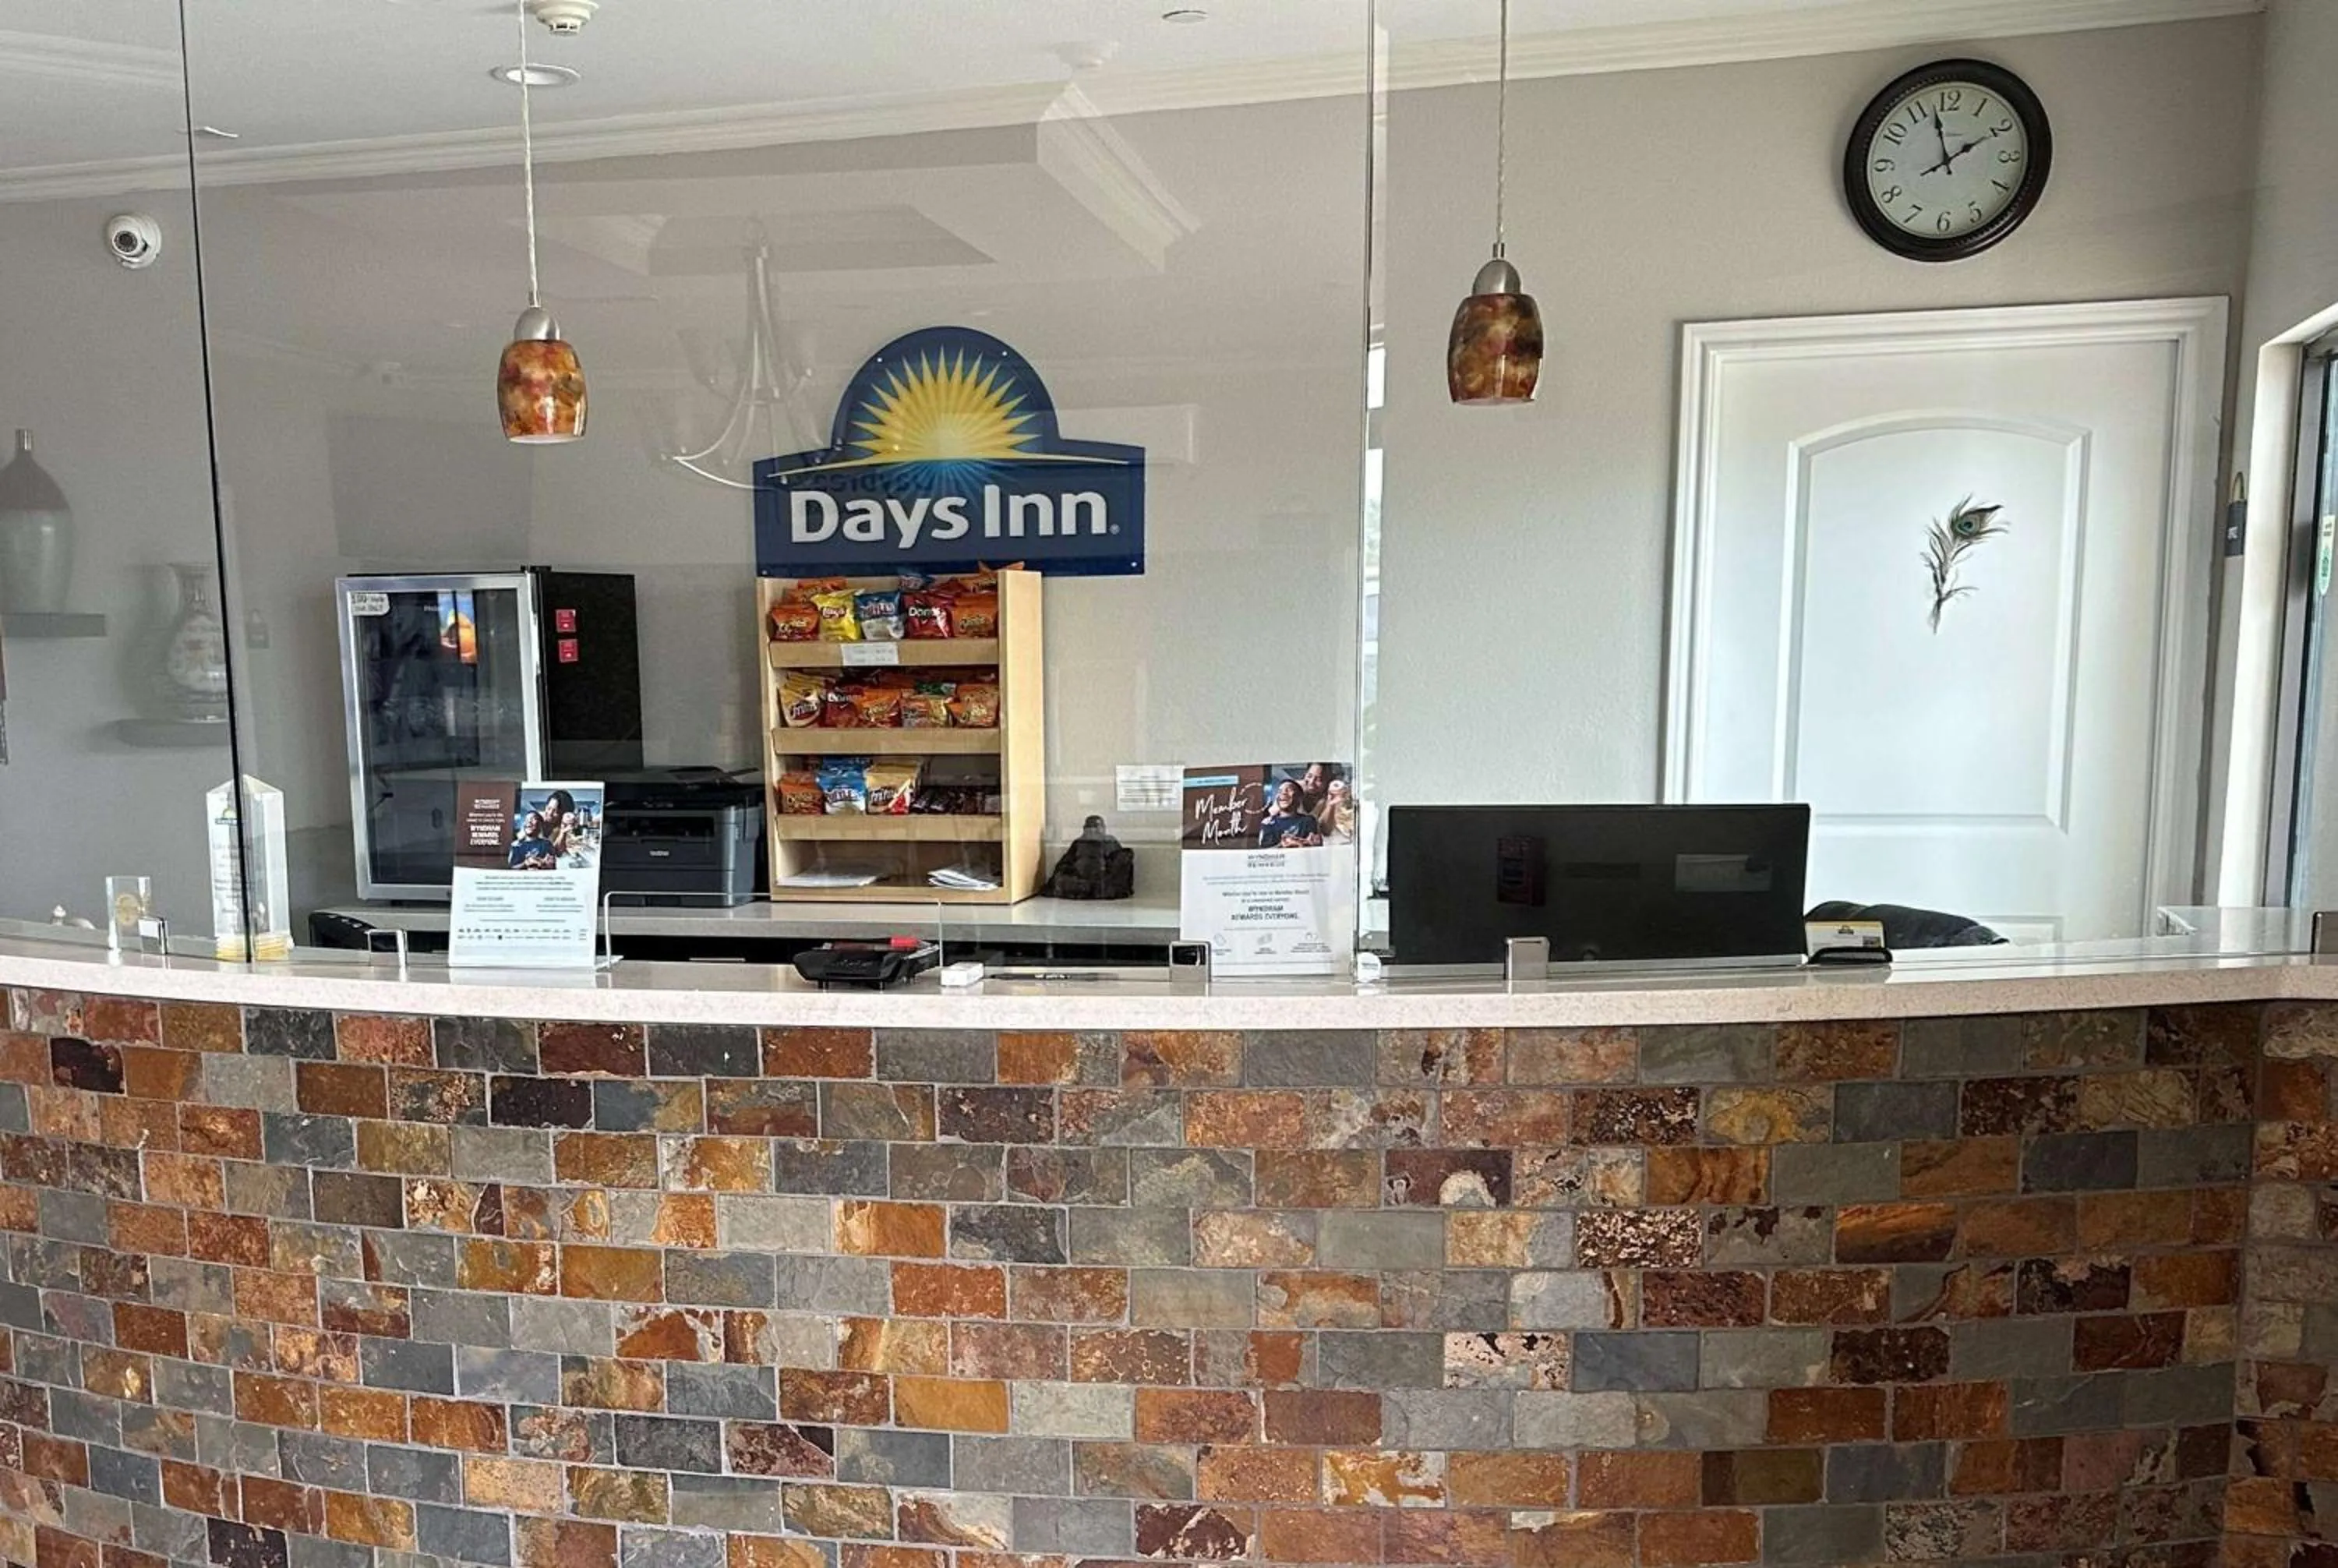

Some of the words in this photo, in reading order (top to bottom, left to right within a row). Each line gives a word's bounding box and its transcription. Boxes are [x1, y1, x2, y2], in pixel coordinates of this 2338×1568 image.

[1940, 90, 1961, 112] 12
[1972, 97, 1988, 117] 1
[1906, 100, 1927, 124] 11
[1883, 122, 1908, 145] 10
[1989, 118, 2013, 138] 2
[1874, 158, 1895, 172] 9
[1998, 150, 2020, 164] 3
[1881, 185, 1902, 203] 8
[1991, 179, 2011, 196] 4
[1903, 203, 1923, 224] 7
[1937, 211, 1951, 232] 6
[1969, 200, 1982, 224] 5
[790, 489, 969, 549] Days
[984, 484, 1107, 538] Inn
